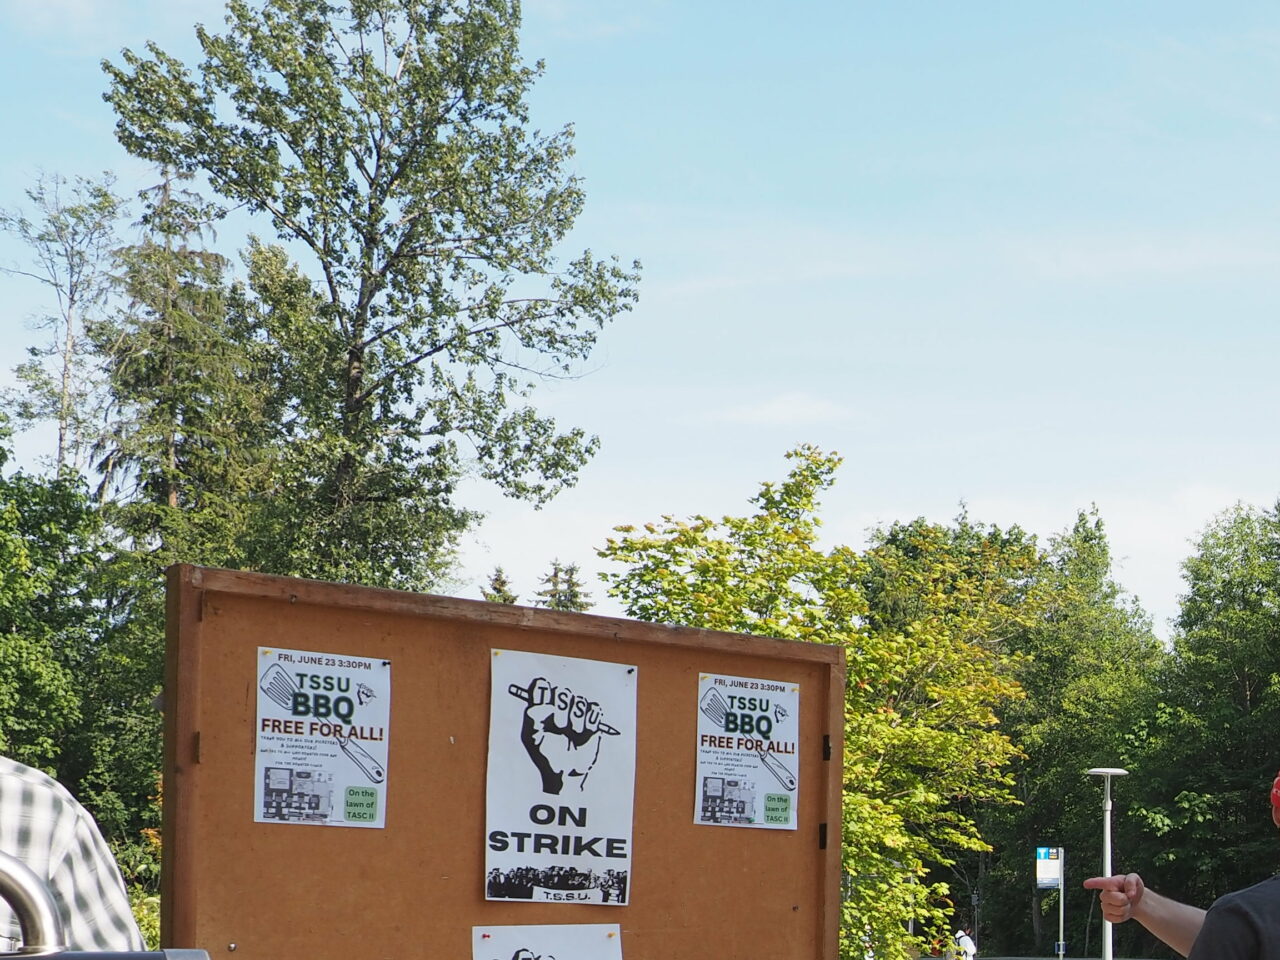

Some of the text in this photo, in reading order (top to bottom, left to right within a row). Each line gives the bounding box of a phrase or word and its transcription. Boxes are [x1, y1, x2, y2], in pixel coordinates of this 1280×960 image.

[278, 654, 372, 670] FRI, JUNE 23 3:30PM
[296, 673, 350, 693] TSSU
[714, 679, 786, 693] FRI, JUNE 23 3:30PM
[292, 693, 355, 725] BBQ
[537, 687, 602, 725] TSSU
[727, 695, 770, 712] TSSU
[261, 718, 384, 741] FREE FOR ALL!
[725, 713, 773, 741] BBQ
[701, 735, 733, 749] FREE
[737, 737, 763, 751] FOR
[767, 741, 795, 755] ALL!
[349, 789, 375, 798] On the
[346, 800, 374, 809] lawn of
[765, 805, 788, 813] lawn of
[347, 811, 367, 820] TASC
[530, 805, 587, 828] ON
[489, 831, 628, 859] STRIKE
[544, 891, 591, 901] T.S.S.U.
